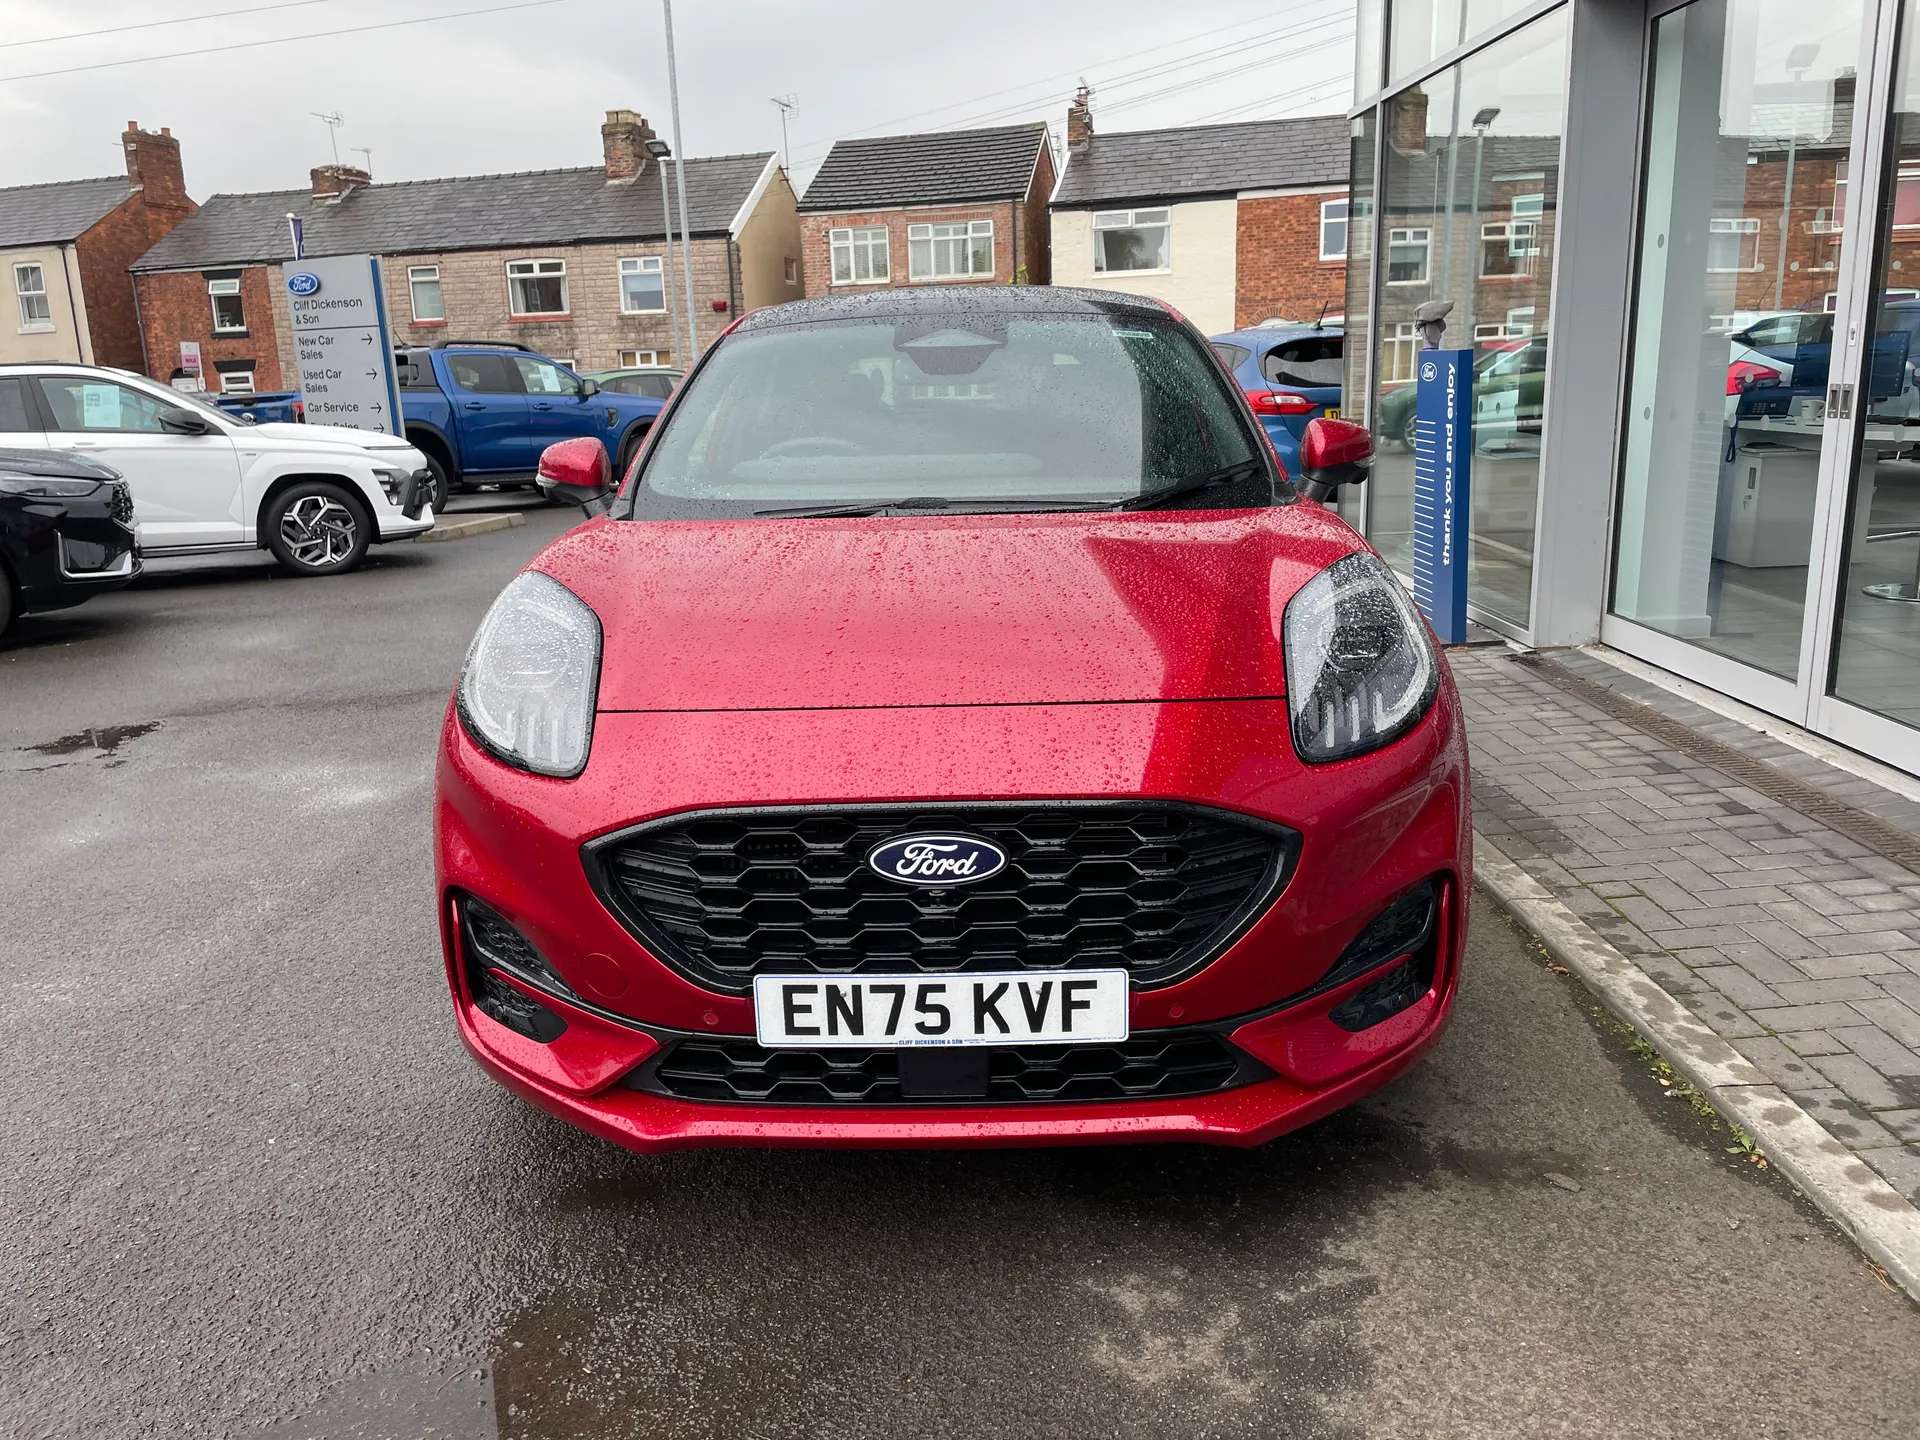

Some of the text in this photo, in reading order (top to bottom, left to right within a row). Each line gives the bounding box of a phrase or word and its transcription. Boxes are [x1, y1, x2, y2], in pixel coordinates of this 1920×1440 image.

[293, 276, 312, 290] Ford
[294, 298, 363, 311] Cliff Dickenson
[295, 314, 320, 324] & Son
[298, 335, 335, 347] New Car
[300, 350, 323, 360] Sales
[303, 368, 342, 380] Used Car
[305, 383, 329, 392] Sales
[1446, 362, 1455, 420] enjoy
[308, 402, 359, 412] Car Service
[1445, 424, 1453, 463] and
[1443, 508, 1451, 566] thank
[896, 843, 979, 875] Ford
[781, 979, 1098, 1036] EN75 KVF
